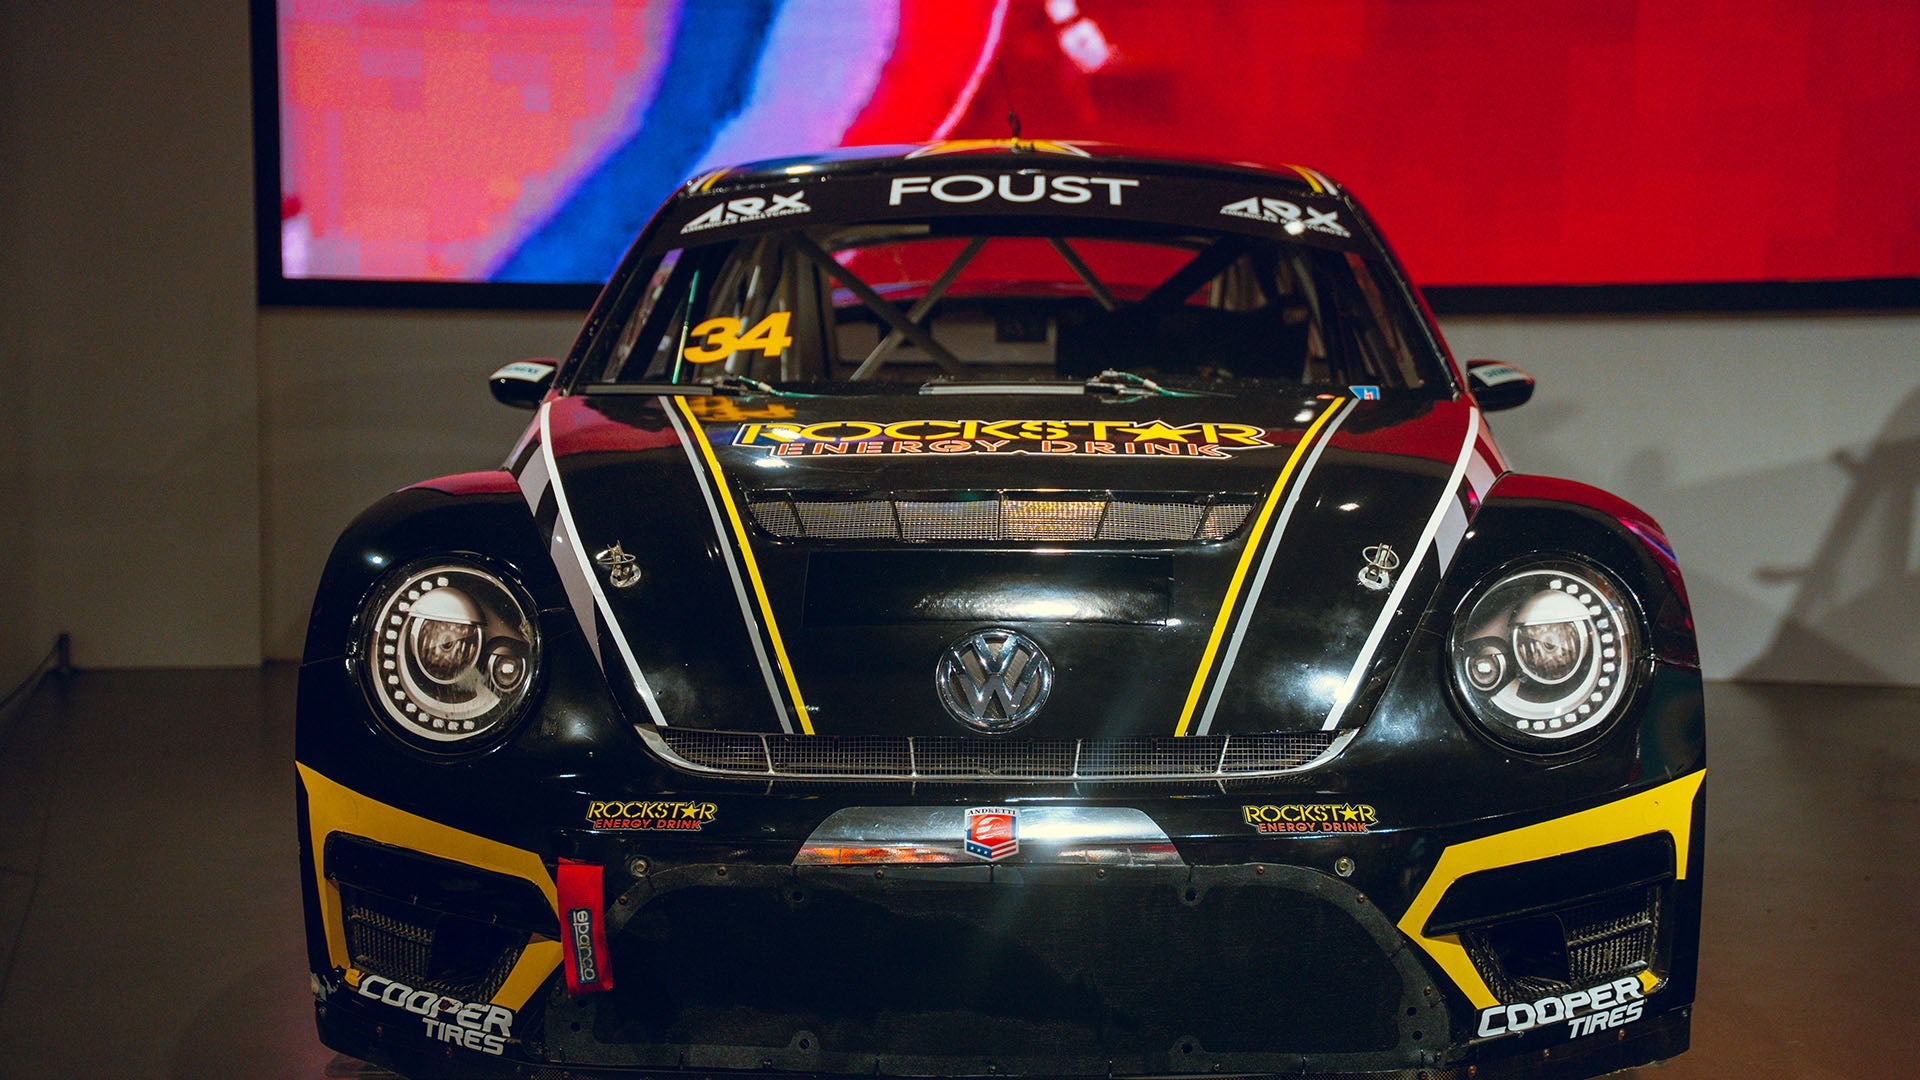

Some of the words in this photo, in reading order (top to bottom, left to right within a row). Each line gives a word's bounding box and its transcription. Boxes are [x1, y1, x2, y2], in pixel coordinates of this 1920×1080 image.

[888, 174, 1140, 206] FOUST
[682, 190, 811, 230] ARX
[1222, 196, 1349, 234] ARX
[683, 311, 793, 364] 34
[741, 420, 1263, 445] ROCKSTAR
[777, 439, 1011, 456] ENERGY
[1041, 439, 1222, 457] DRINK
[944, 633, 1047, 723] VW
[587, 801, 716, 819] ROCKSTAR
[594, 818, 652, 829] ENERGY
[656, 818, 701, 830] DRINK
[967, 808, 1016, 816] ANDRETTI
[1244, 805, 1376, 823] ROCKSTAR
[1258, 822, 1316, 833] ENERGY
[1321, 822, 1368, 833] DRINK
[572, 910, 596, 982] sparco
[357, 974, 513, 1038] COOPER
[1477, 976, 1644, 1038] COOPER
[1567, 1000, 1645, 1040] TIRES
[421, 1016, 507, 1056] TIRES
